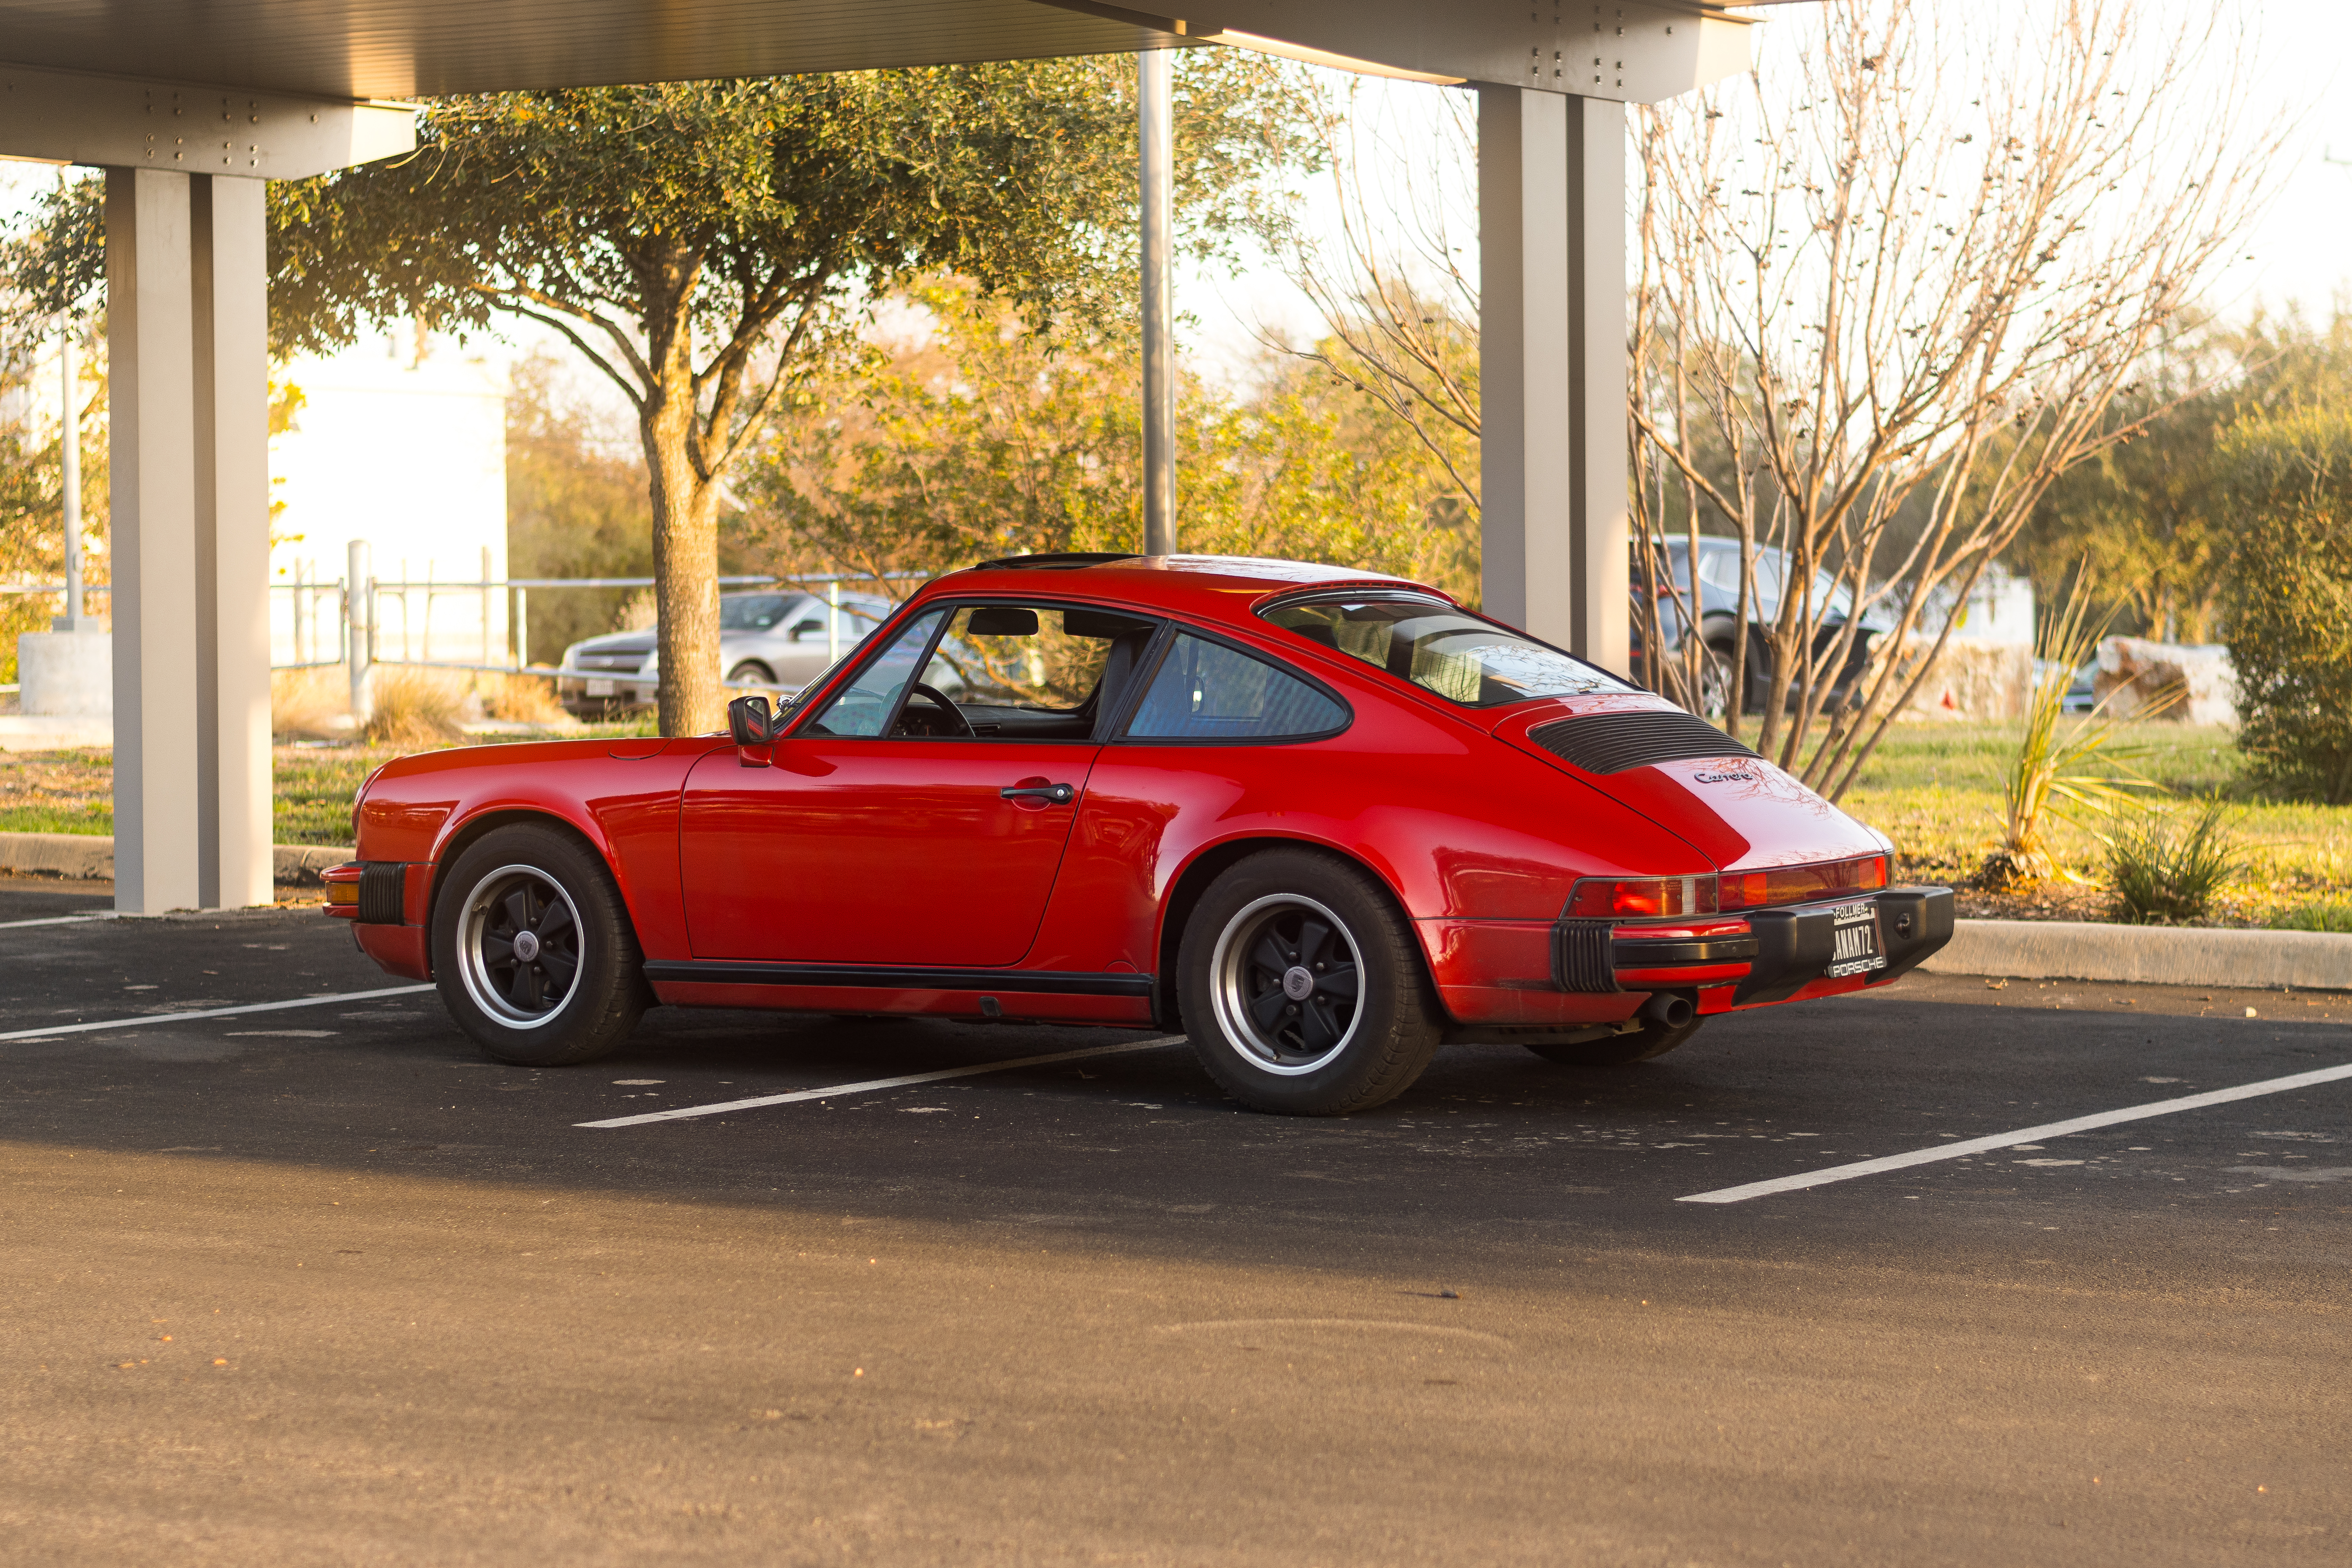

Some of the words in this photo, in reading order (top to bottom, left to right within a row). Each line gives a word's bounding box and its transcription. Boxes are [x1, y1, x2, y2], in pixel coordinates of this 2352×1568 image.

[1836, 903, 1865, 918] FOLLMER
[1832, 925, 1873, 961] ANAM72
[1833, 956, 1884, 977] PORSCHE
